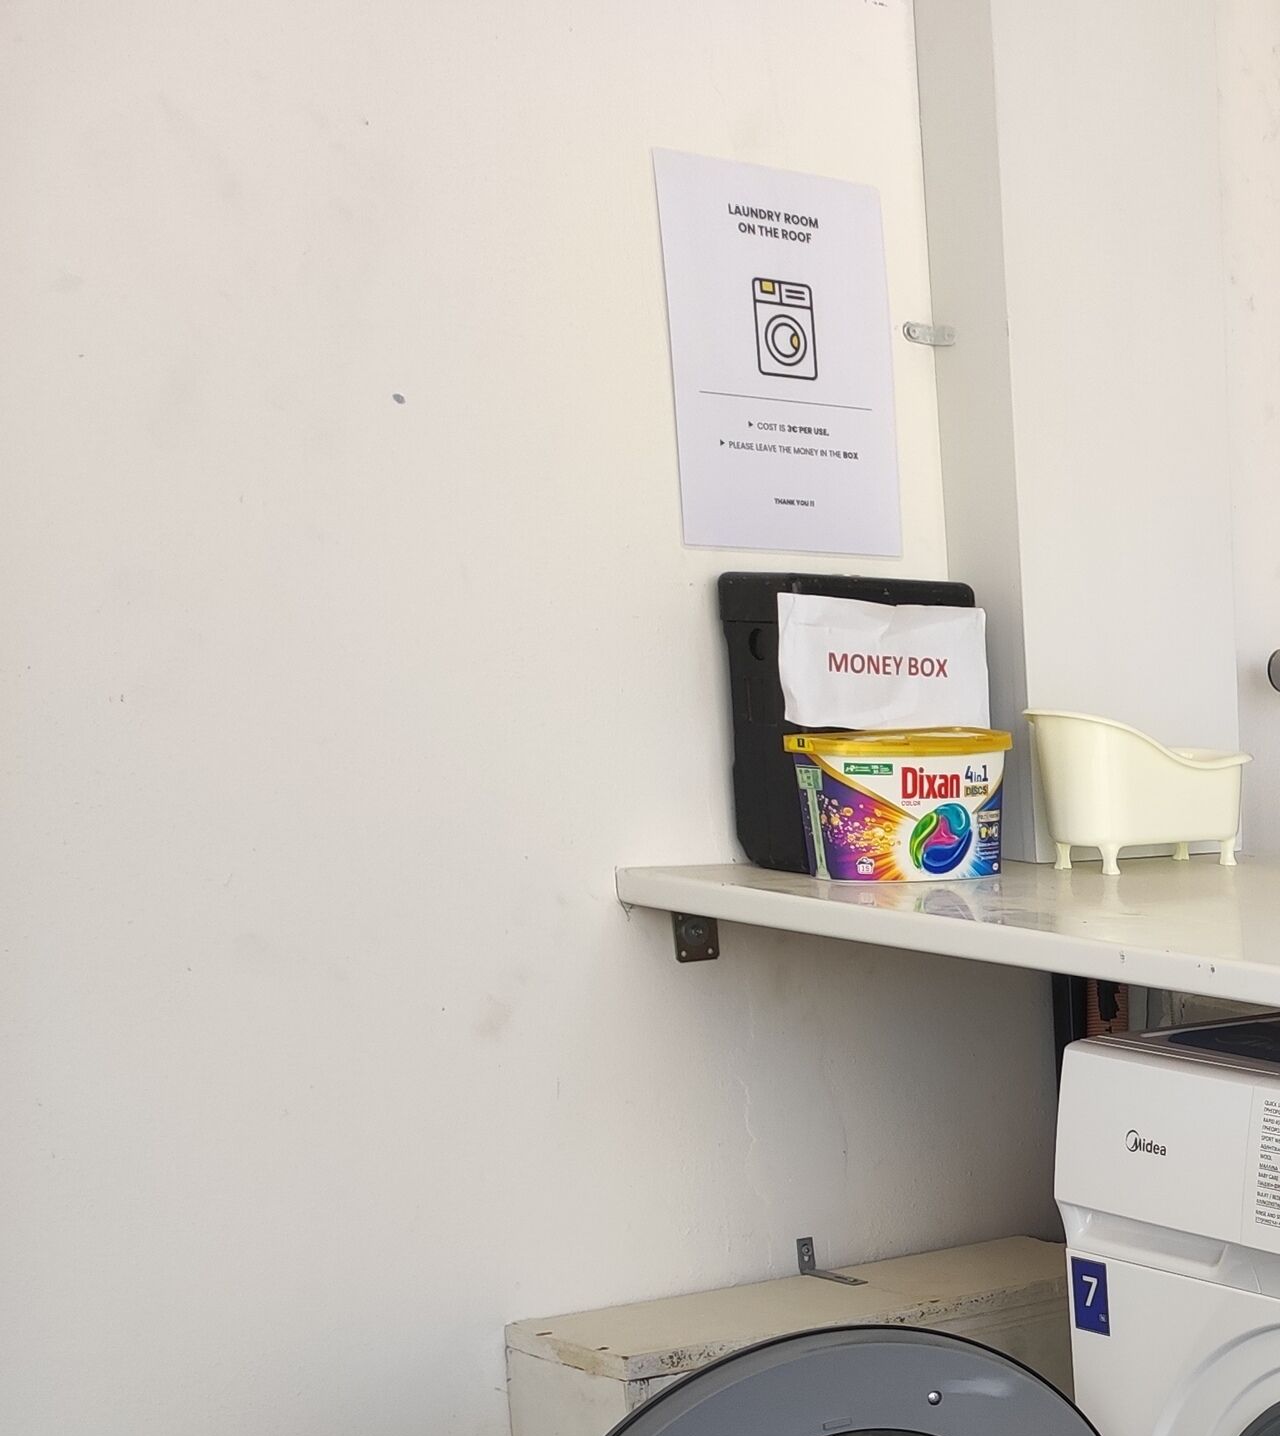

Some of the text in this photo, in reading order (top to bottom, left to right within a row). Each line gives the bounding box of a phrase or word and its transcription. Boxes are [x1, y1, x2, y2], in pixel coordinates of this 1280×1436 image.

[728, 203, 819, 229] LAUNDRY ROOM
[738, 222, 812, 244] ON THE ROOF
[757, 422, 777, 431] COST
[779, 424, 786, 432] IS
[799, 426, 812, 435] PER
[728, 440, 859, 460] PLEASE LEAVE THE MONEY IN THE BOX
[774, 498, 809, 507] THANK YOU
[828, 651, 948, 678] MONEY BOX
[901, 766, 960, 800] Dixan
[965, 765, 989, 783] 4in1
[1126, 1129, 1167, 1156] Midea
[1081, 1274, 1098, 1307] 7
